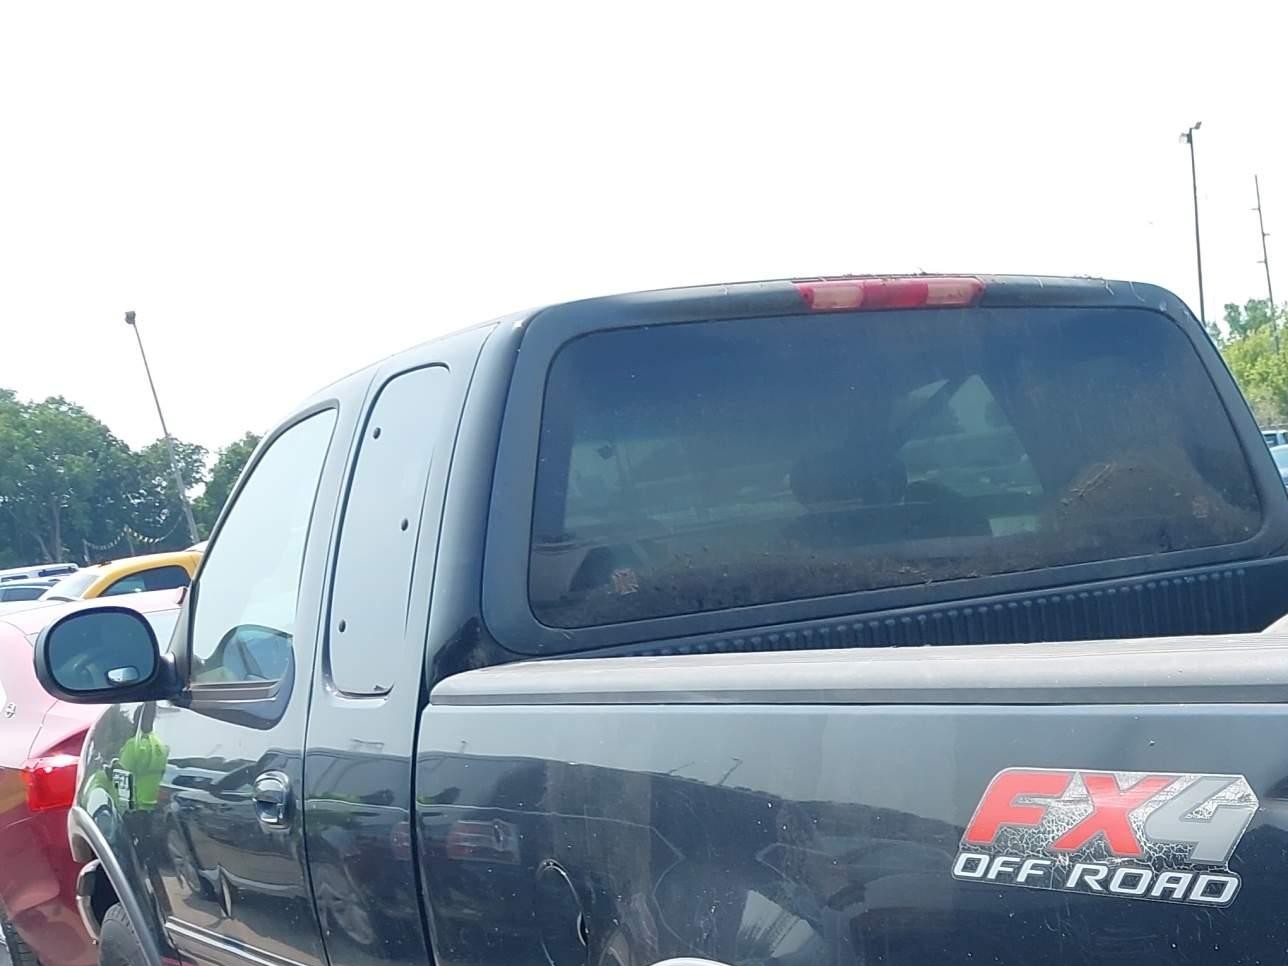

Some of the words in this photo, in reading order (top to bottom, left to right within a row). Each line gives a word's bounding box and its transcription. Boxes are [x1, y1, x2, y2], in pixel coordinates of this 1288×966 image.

[963, 770, 1259, 866] FX4
[953, 852, 1051, 883] OFF
[1065, 863, 1240, 902] ROAD
